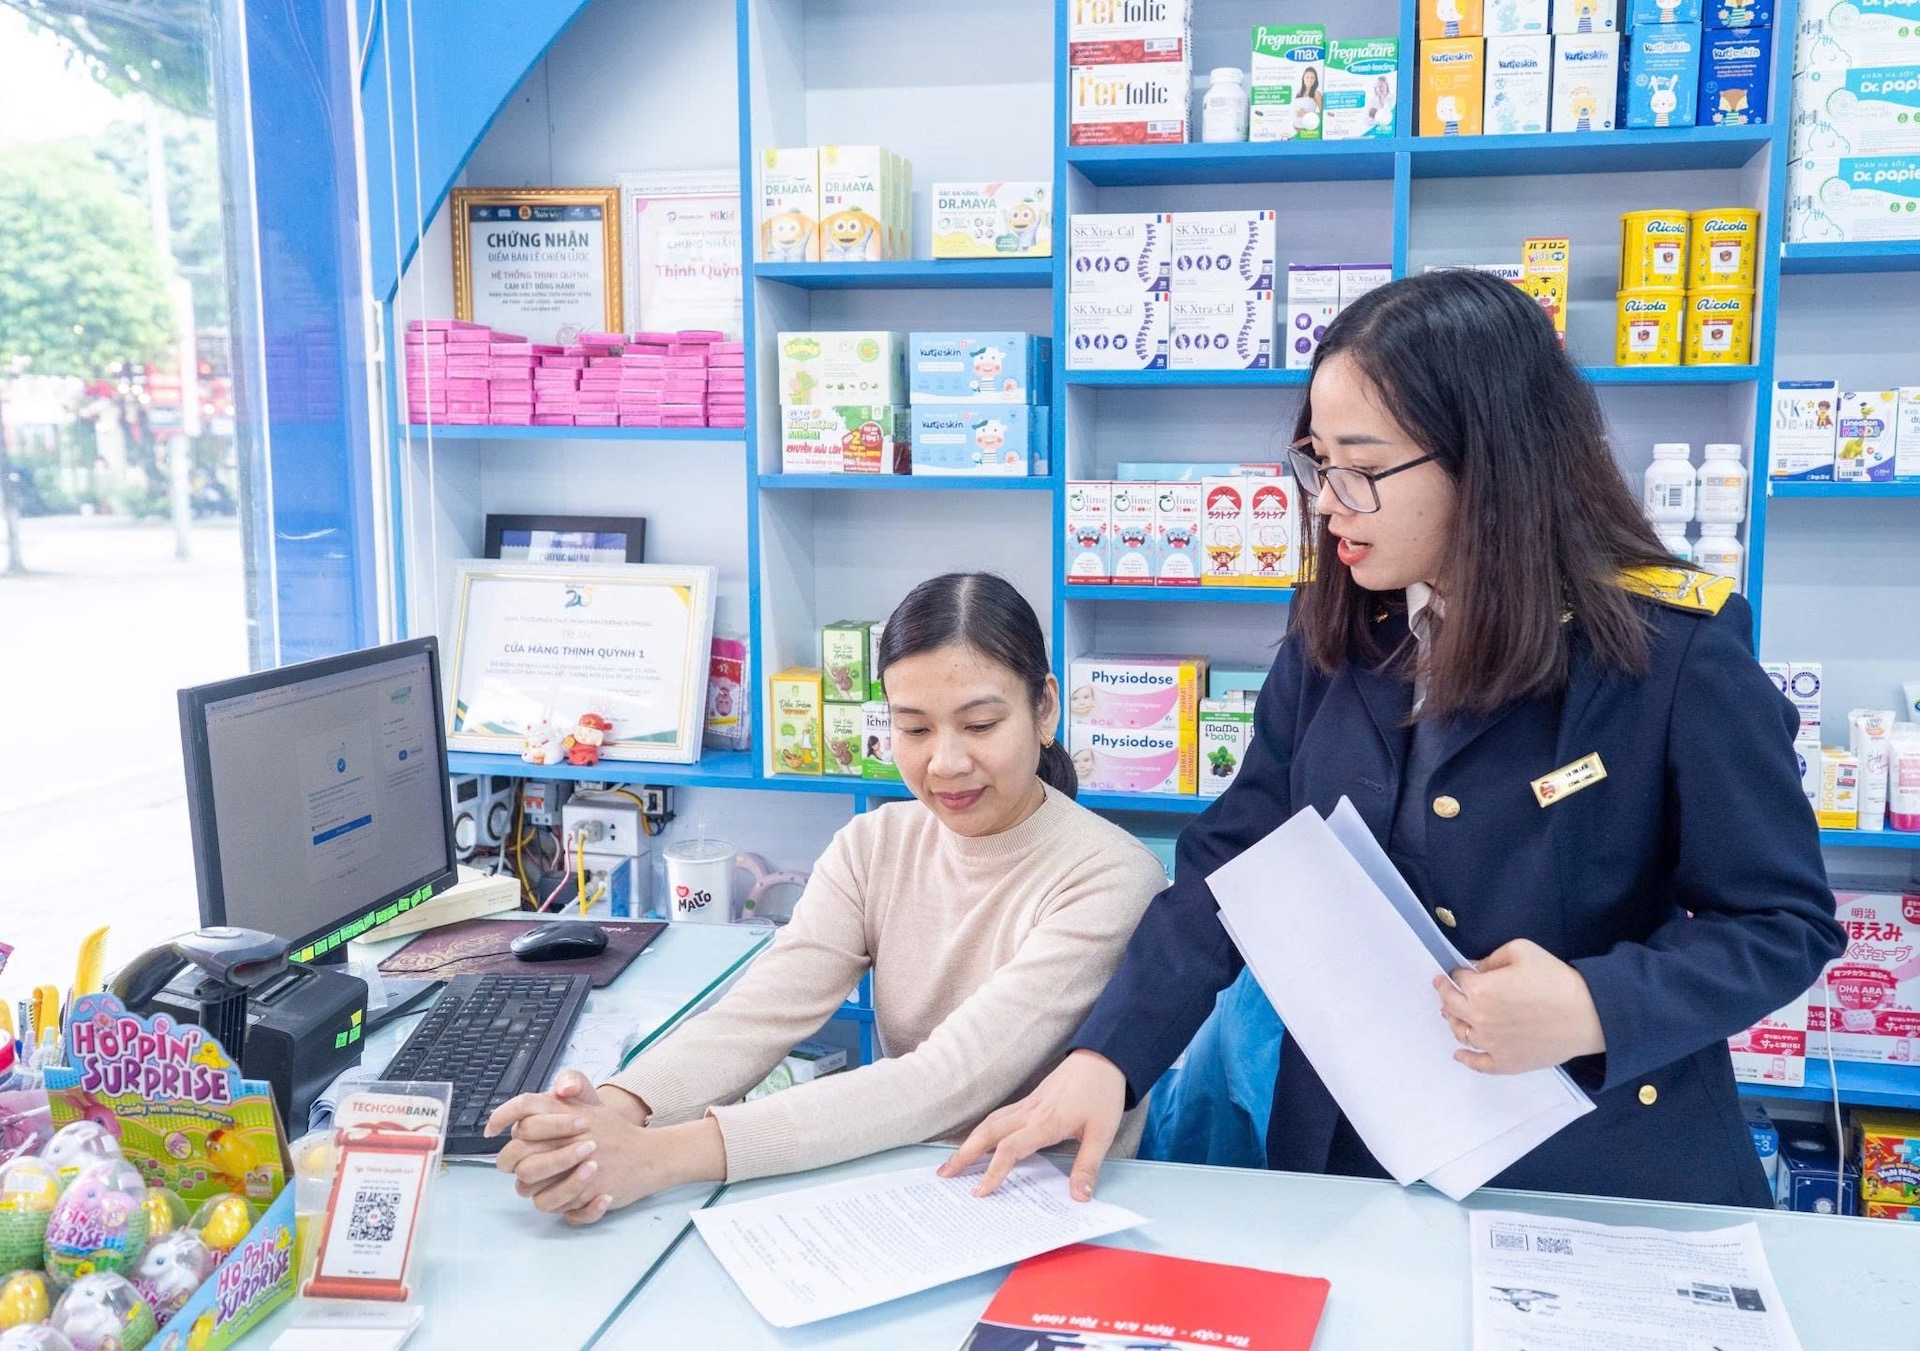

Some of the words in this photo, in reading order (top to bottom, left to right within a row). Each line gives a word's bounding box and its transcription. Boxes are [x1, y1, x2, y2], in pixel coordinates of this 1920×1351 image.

[1255, 26, 1323, 50] Pregnacare
[1294, 49, 1320, 61] max
[1327, 40, 1395, 64] Pregnacare
[1860, 82, 1880, 93] Dr.
[1853, 171, 1872, 182] Dr.
[765, 183, 813, 196] DR.MAYA
[825, 181, 875, 193] DR.MAYA
[938, 198, 997, 209] DR.MAYA
[1647, 220, 1686, 233] Ricola
[1704, 220, 1748, 232] Ricola
[487, 229, 541, 248] CHỨNG
[545, 229, 589, 251] NHẬN
[655, 264, 697, 281] Thịnh
[701, 263, 741, 281] Quỳn
[1625, 300, 1667, 312] Ricola
[1697, 298, 1740, 310] Ricola
[504, 641, 525, 653] CỬA
[528, 643, 559, 655] HÀNG
[562, 646, 595, 658] THỊNH
[598, 645, 635, 659] QUỲNH
[639, 649, 645, 659] 1
[1092, 671, 1174, 687] Physiodose
[1092, 734, 1174, 750] Physiodose
[1210, 732, 1237, 743] baby
[678, 889, 712, 913] MALTO
[1851, 907, 1876, 920] 明治
[1839, 984, 1860, 994] DHA
[1861, 985, 1883, 995] ARA
[73, 1018, 199, 1065] HOPPIN'
[83, 1057, 229, 1104] SURPRISE
[117, 1105, 146, 1118] Candy
[149, 1104, 169, 1114] with
[171, 1105, 211, 1120] wind-up
[212, 1111, 233, 1123] toys
[353, 1102, 439, 1118] TECHCOMBANK
[216, 1247, 290, 1327] SURPRISE
